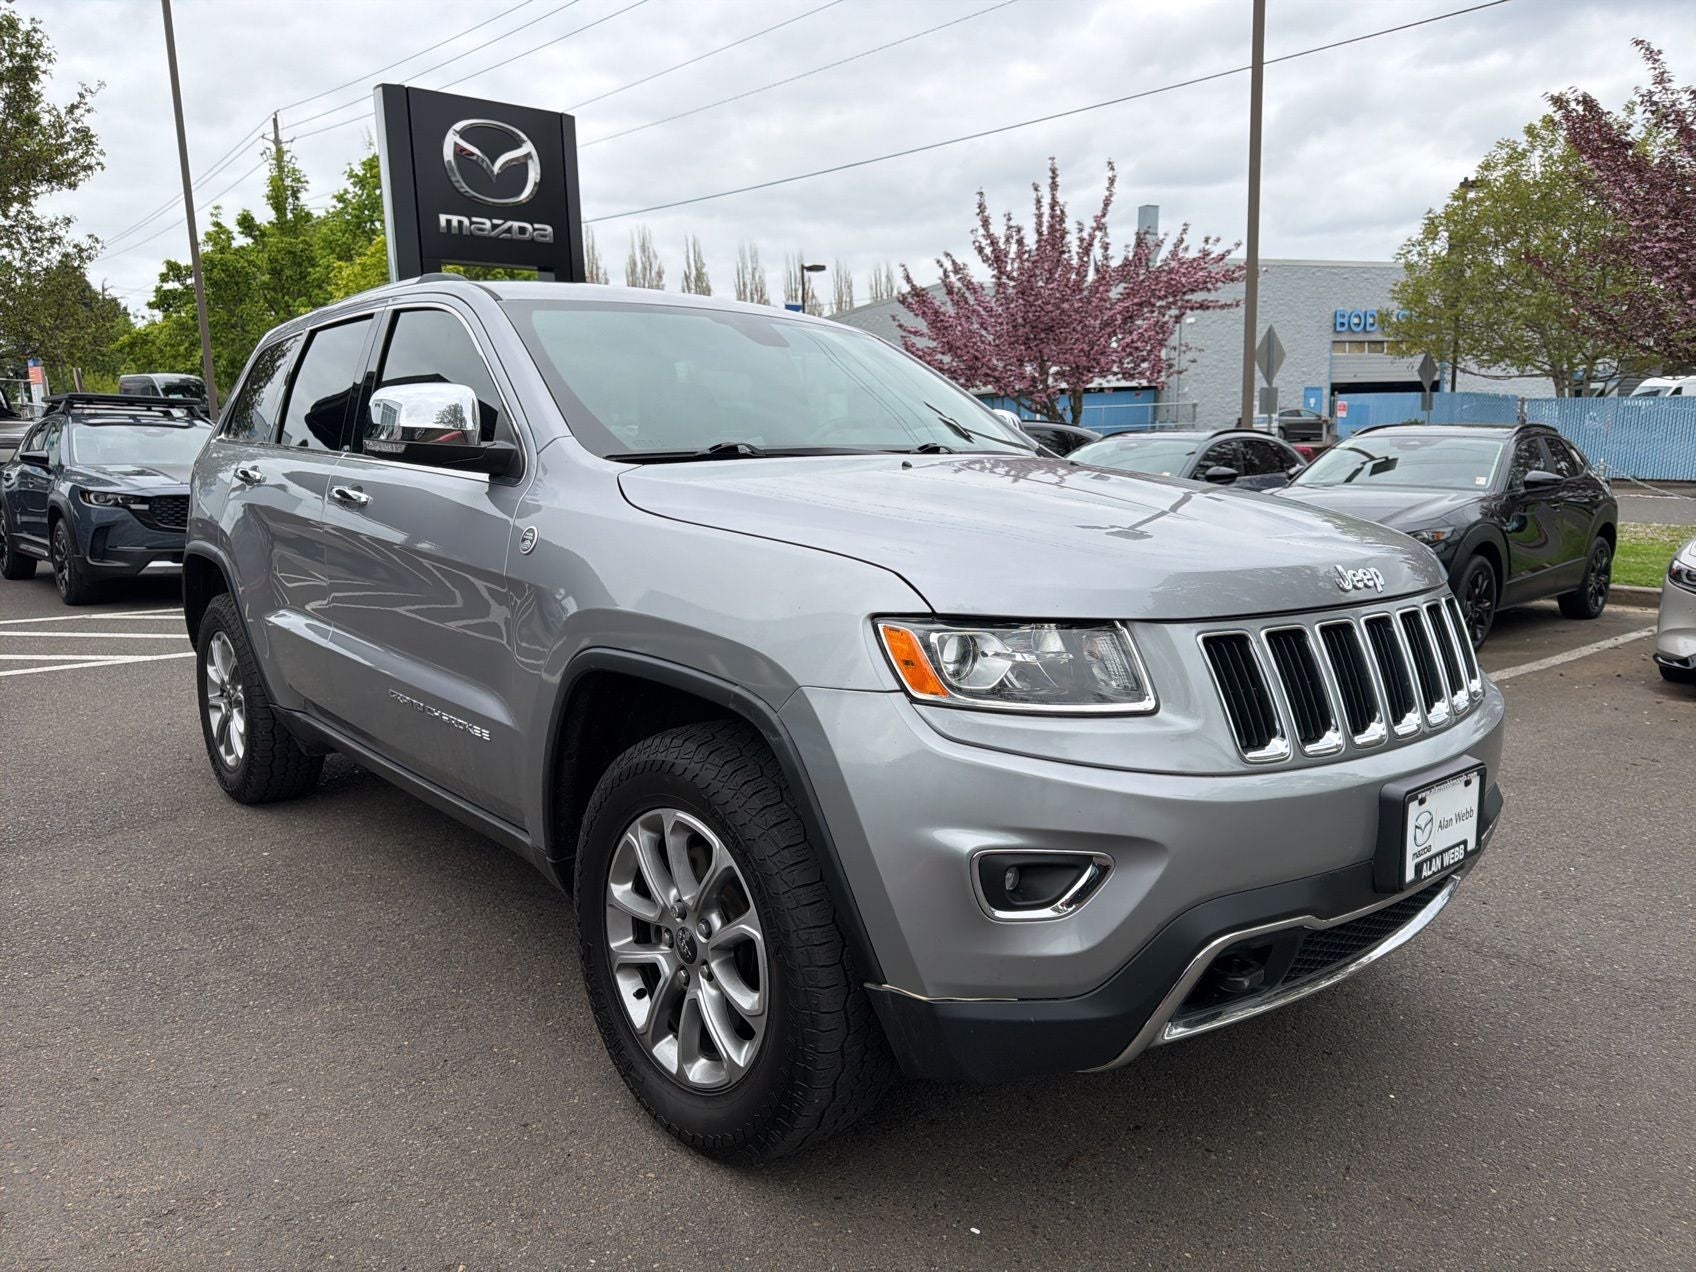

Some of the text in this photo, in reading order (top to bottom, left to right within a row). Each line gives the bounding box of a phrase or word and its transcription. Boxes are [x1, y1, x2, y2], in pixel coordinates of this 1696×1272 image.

[438, 213, 554, 244] mazda
[1335, 309, 1383, 333] BOD
[1334, 564, 1385, 593] Jeep
[1437, 806, 1475, 833] Alan Webb
[1411, 844, 1433, 862] mazda
[1421, 844, 1465, 879] ALAN WEBB
